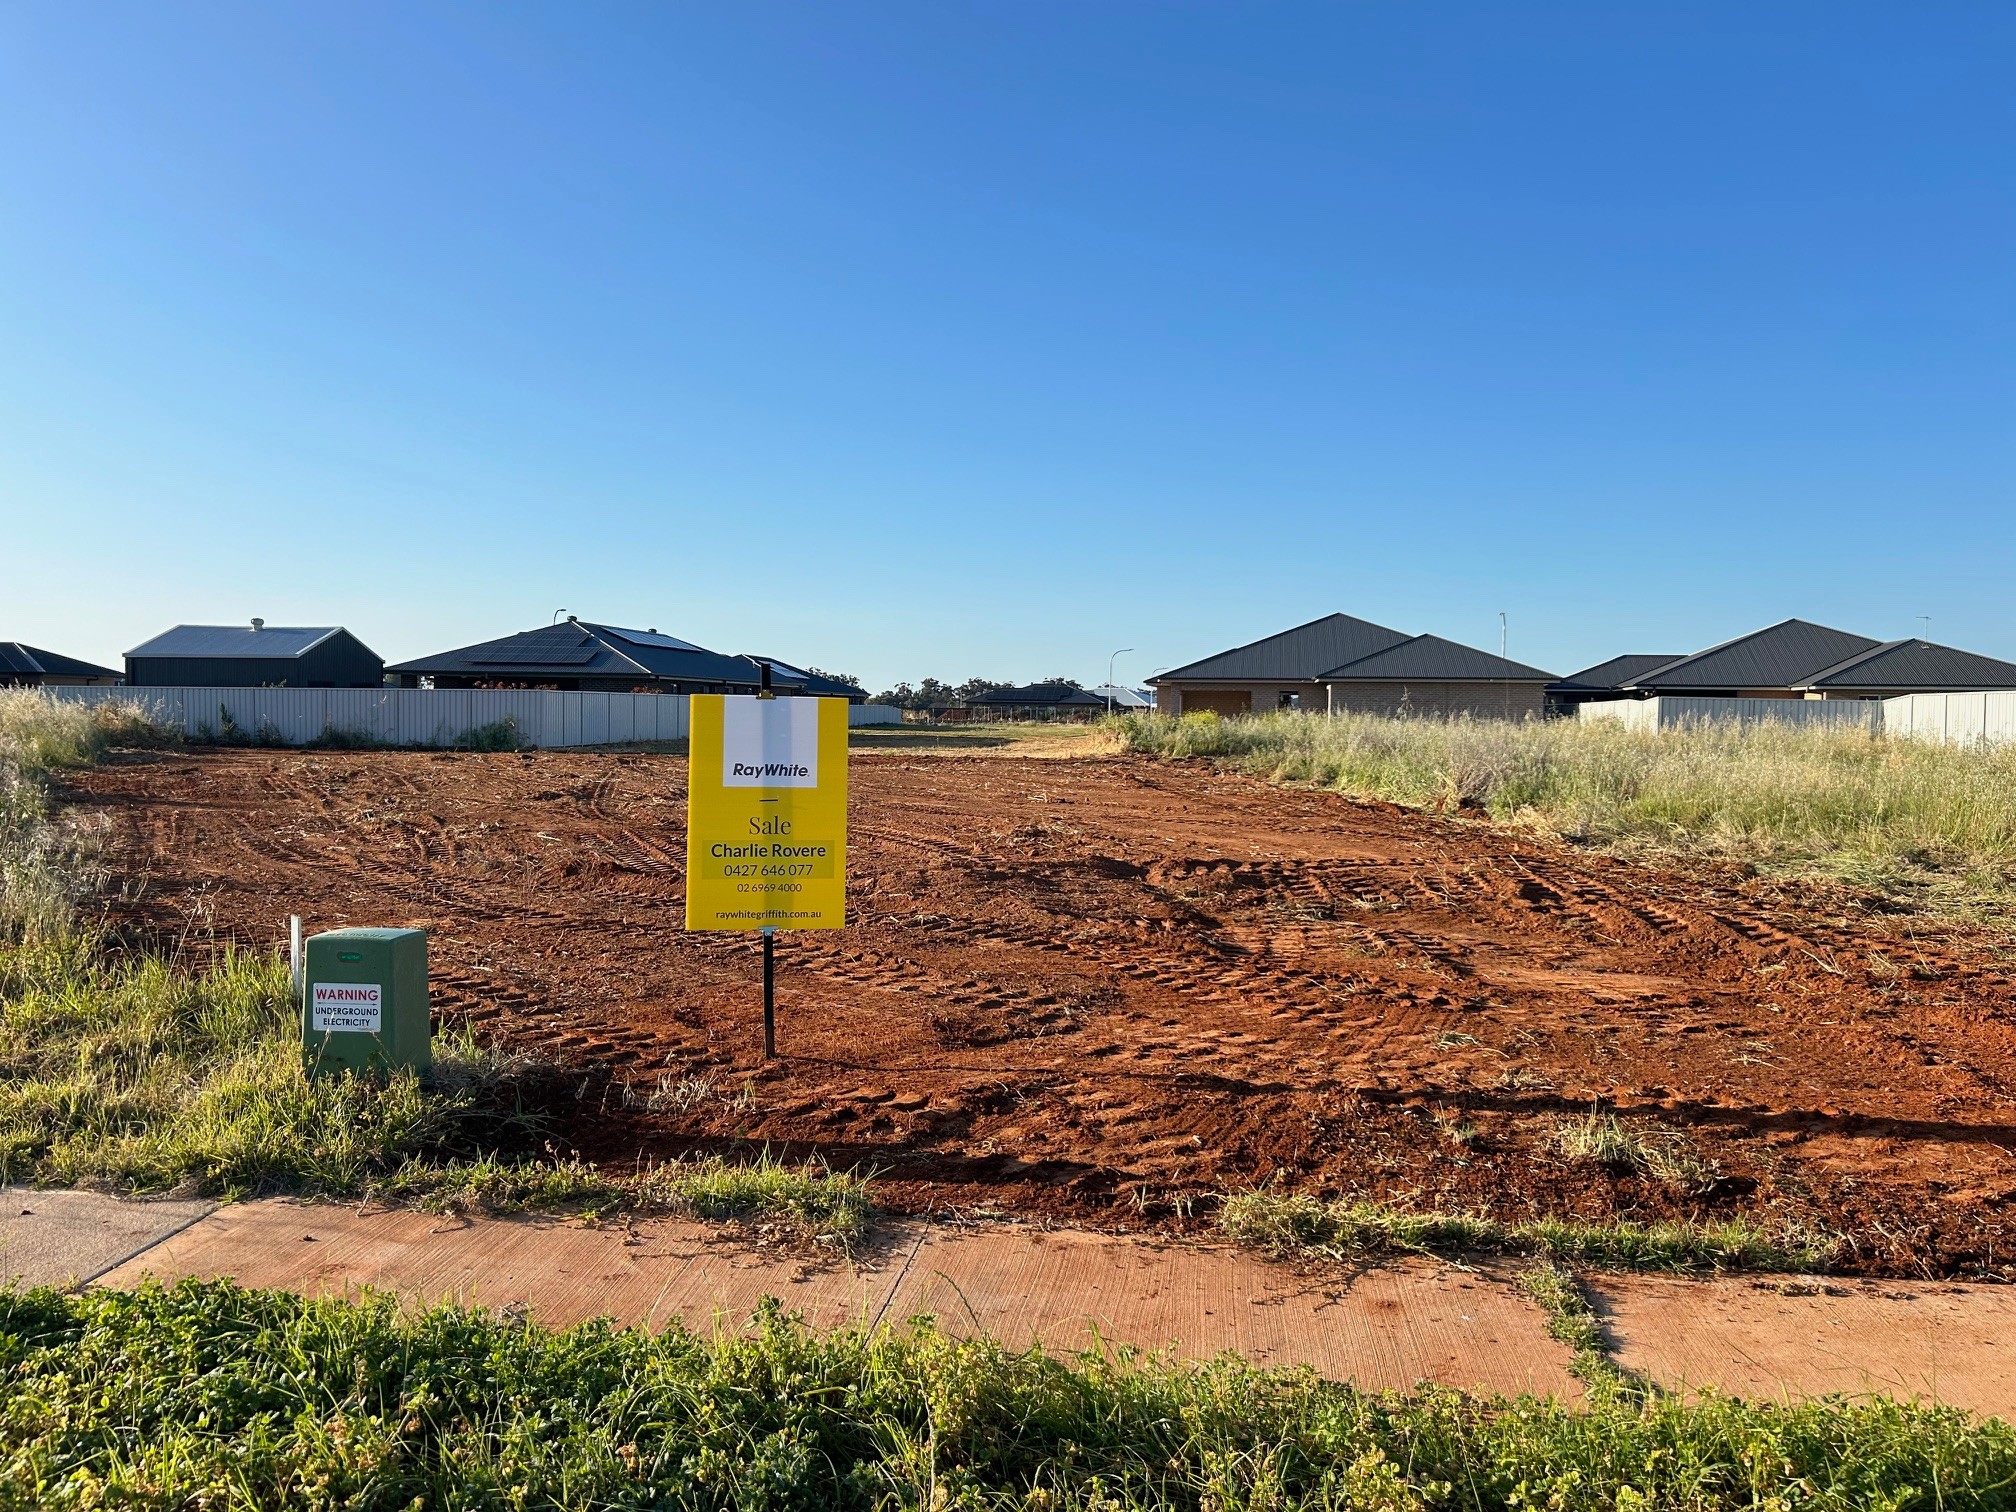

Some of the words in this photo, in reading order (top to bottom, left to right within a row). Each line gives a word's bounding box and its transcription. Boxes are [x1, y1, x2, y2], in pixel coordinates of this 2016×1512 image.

[749, 816, 791, 835] Sale
[711, 844, 768, 857] Charlie
[772, 844, 826, 857] Rovere
[724, 865, 758, 876] 0427
[761, 865, 786, 876] 646
[788, 865, 813, 876] 077
[737, 883, 750, 892] 02
[751, 883, 776, 892] 6969
[778, 883, 802, 892] 4000
[715, 910, 822, 920] raywhitegriffith.com.au
[316, 989, 379, 1001] WARNING
[315, 1007, 379, 1016] UNDERGROUND
[323, 1018, 370, 1026] ELECTRICITY
